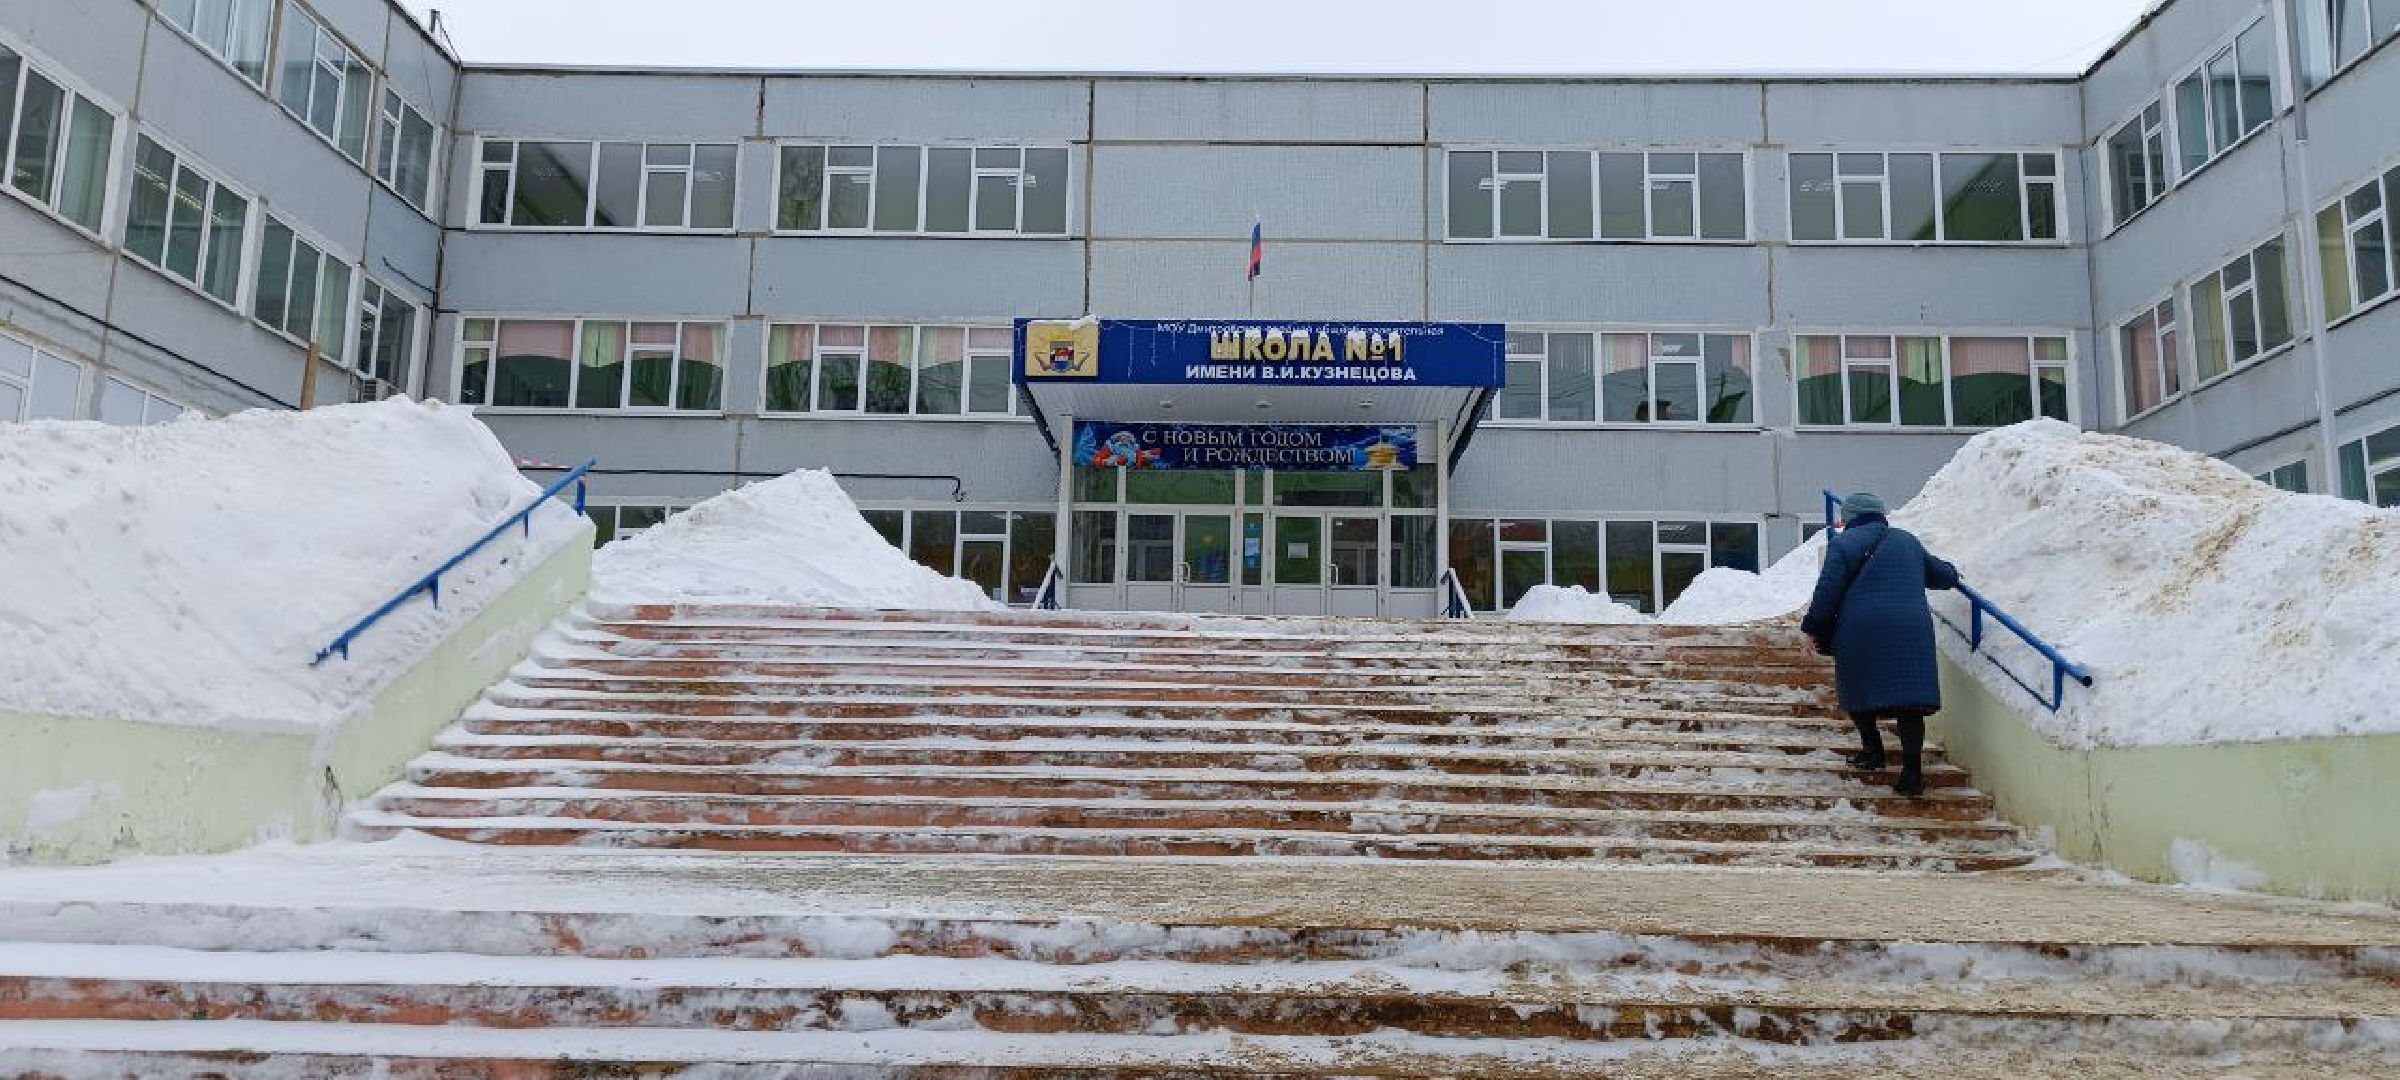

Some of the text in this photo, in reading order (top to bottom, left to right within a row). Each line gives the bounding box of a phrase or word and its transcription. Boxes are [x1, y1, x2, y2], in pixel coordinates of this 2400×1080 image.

[1210, 329, 1402, 360] ШКОЛА №1
[1185, 366, 1416, 382] ИМЕНИ В.И.КУЗНЕЦОВА
[1142, 430, 1321, 446] С НОВЫМ ГОДОМ
[1184, 447, 1197, 462] И
